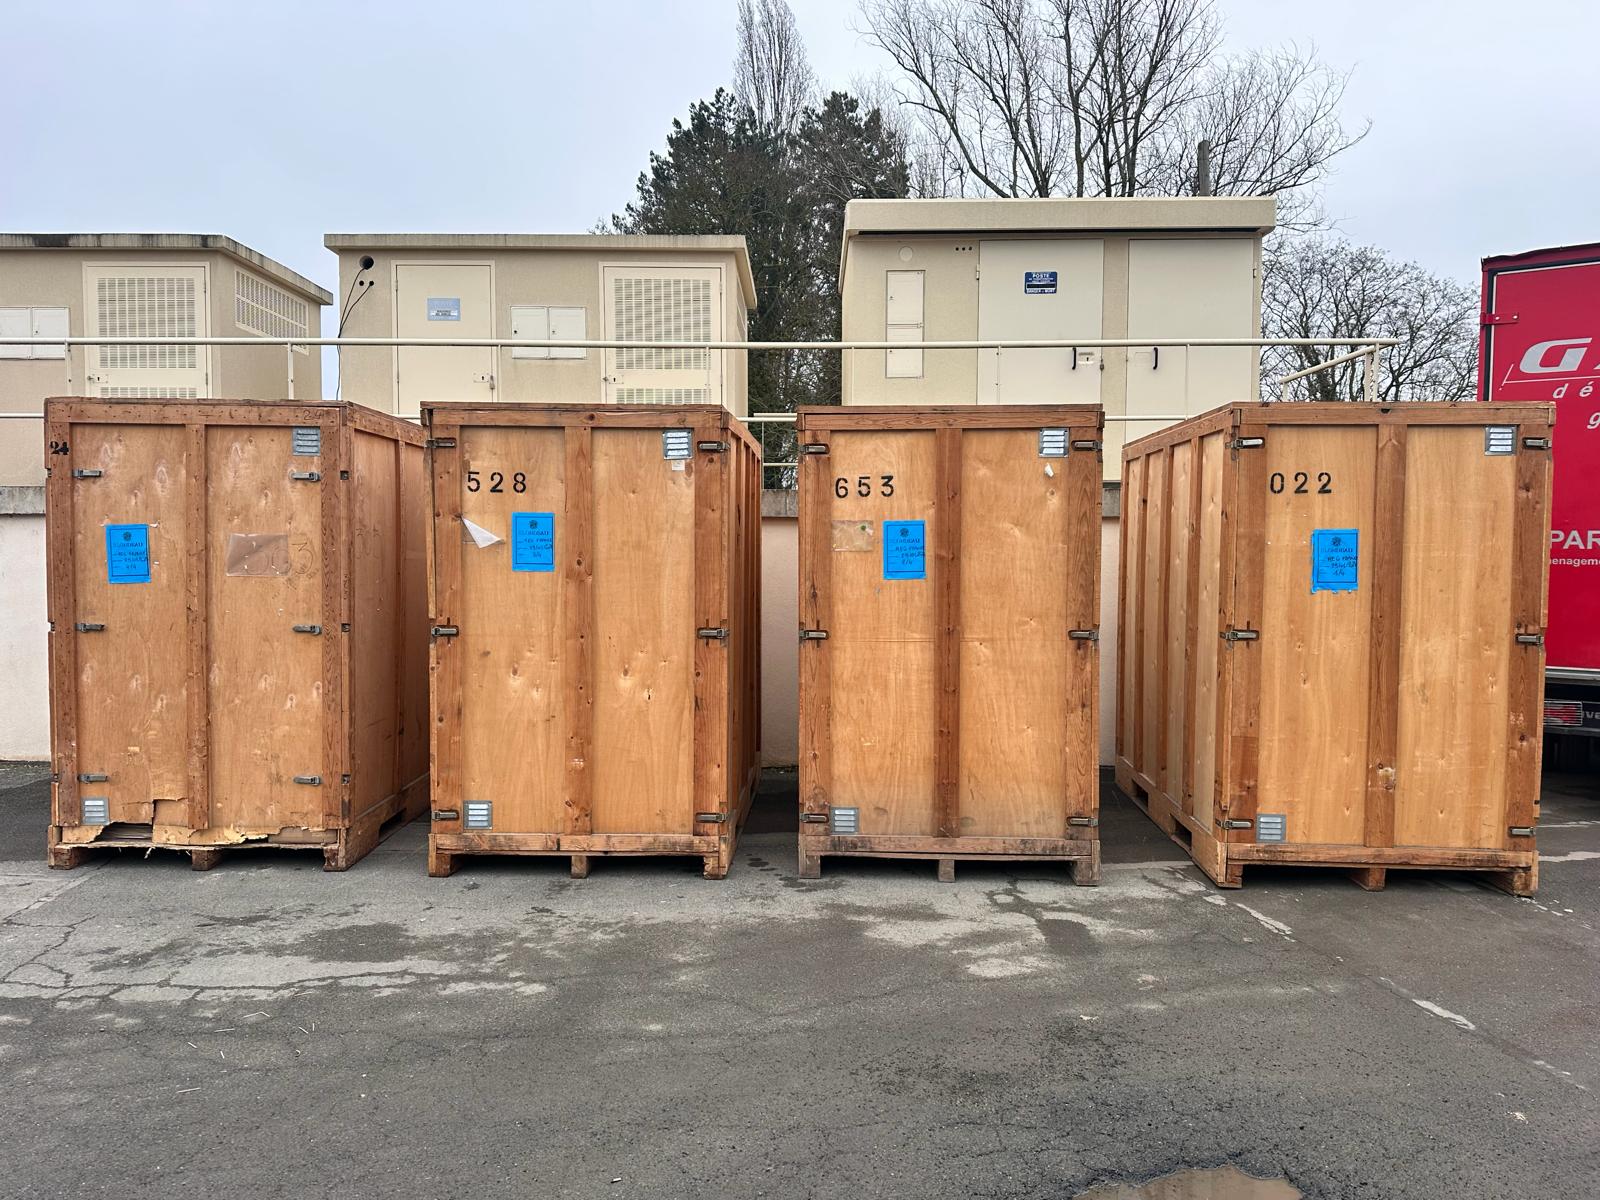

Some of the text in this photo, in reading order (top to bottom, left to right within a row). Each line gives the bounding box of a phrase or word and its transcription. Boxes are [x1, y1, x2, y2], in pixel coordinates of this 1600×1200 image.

[1519, 337, 1600, 373] G
[50, 441, 69, 455] 24
[467, 471, 526, 493] 528
[835, 475, 894, 498] 653
[1270, 472, 1332, 494] 022
